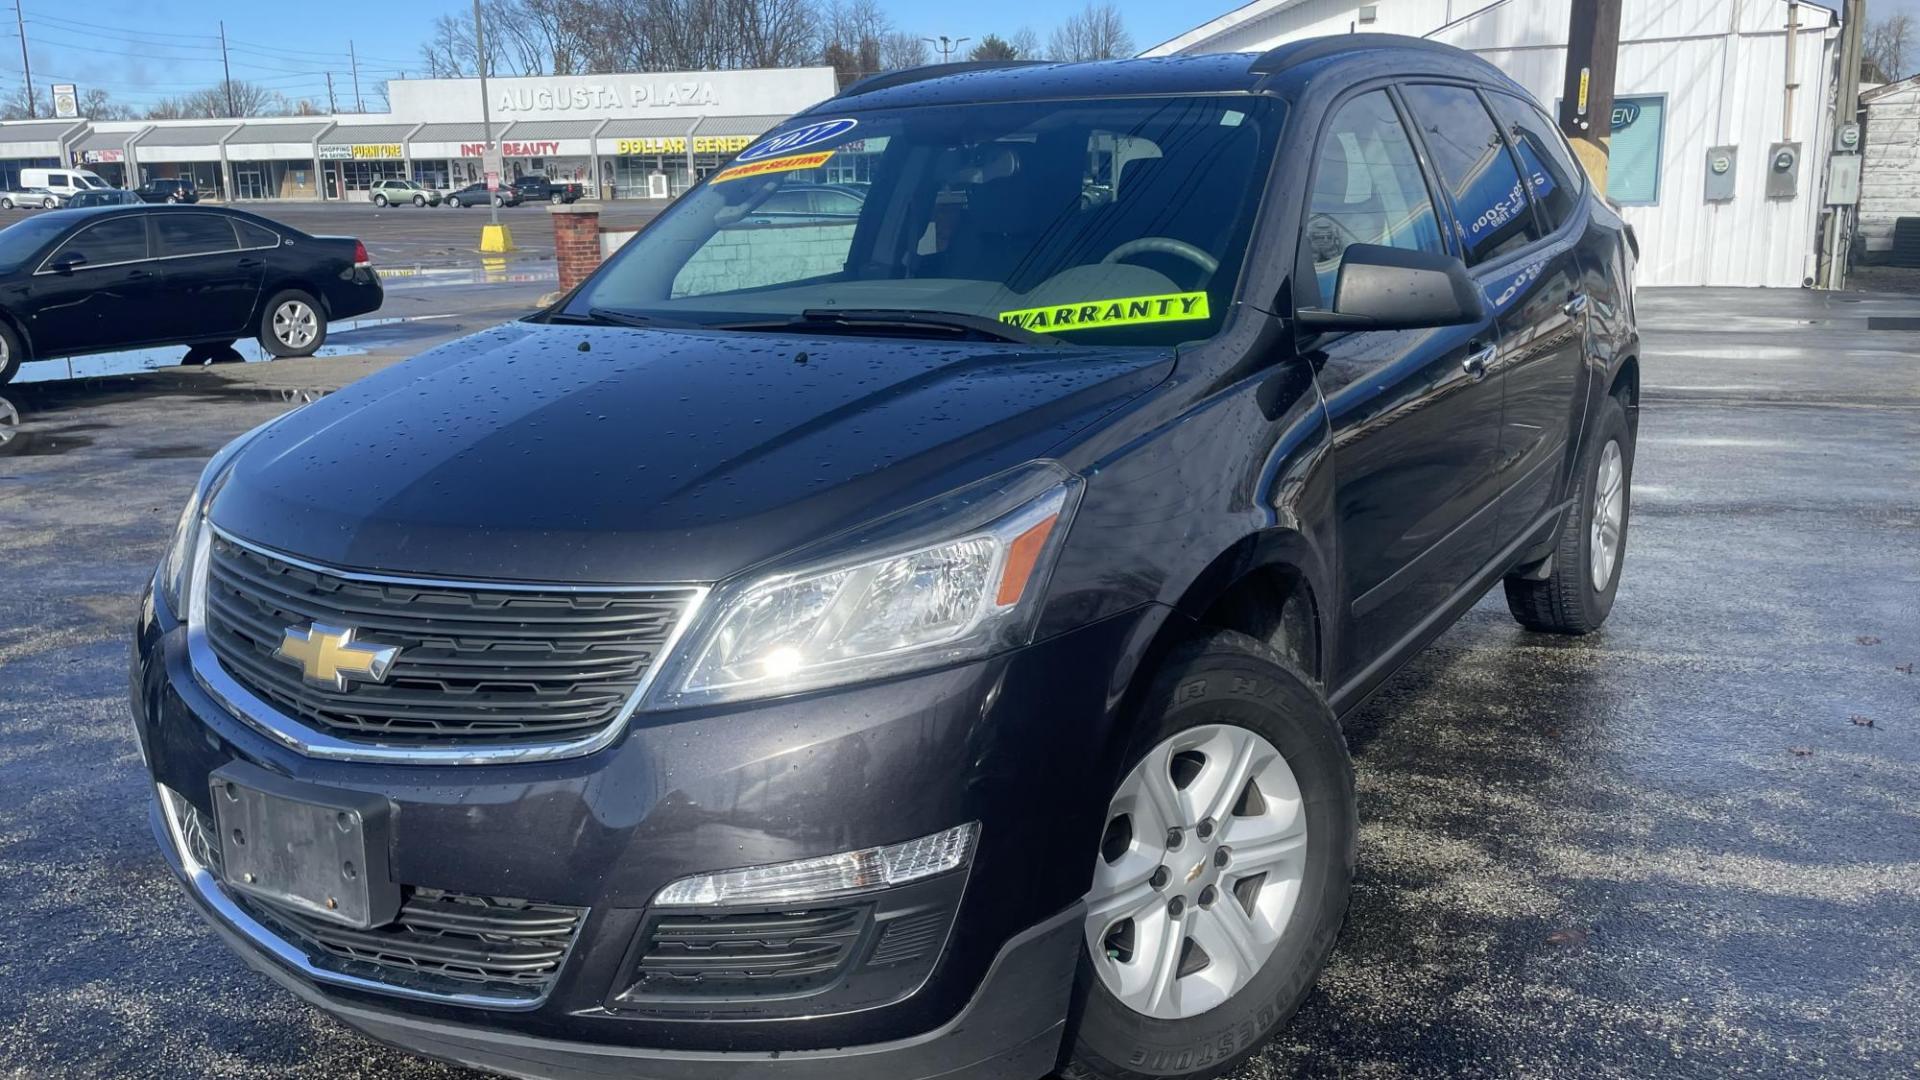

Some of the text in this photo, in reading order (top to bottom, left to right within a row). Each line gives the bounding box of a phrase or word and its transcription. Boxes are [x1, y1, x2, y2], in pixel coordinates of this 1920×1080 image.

[498, 81, 719, 112] AUGUSTA PLAZA
[503, 142, 560, 156] BEAUTY
[618, 139, 686, 154] DOLLAR
[751, 121, 842, 156] 2017
[353, 144, 401, 158] FURNITURE
[1001, 296, 1201, 329] WARRANTY
